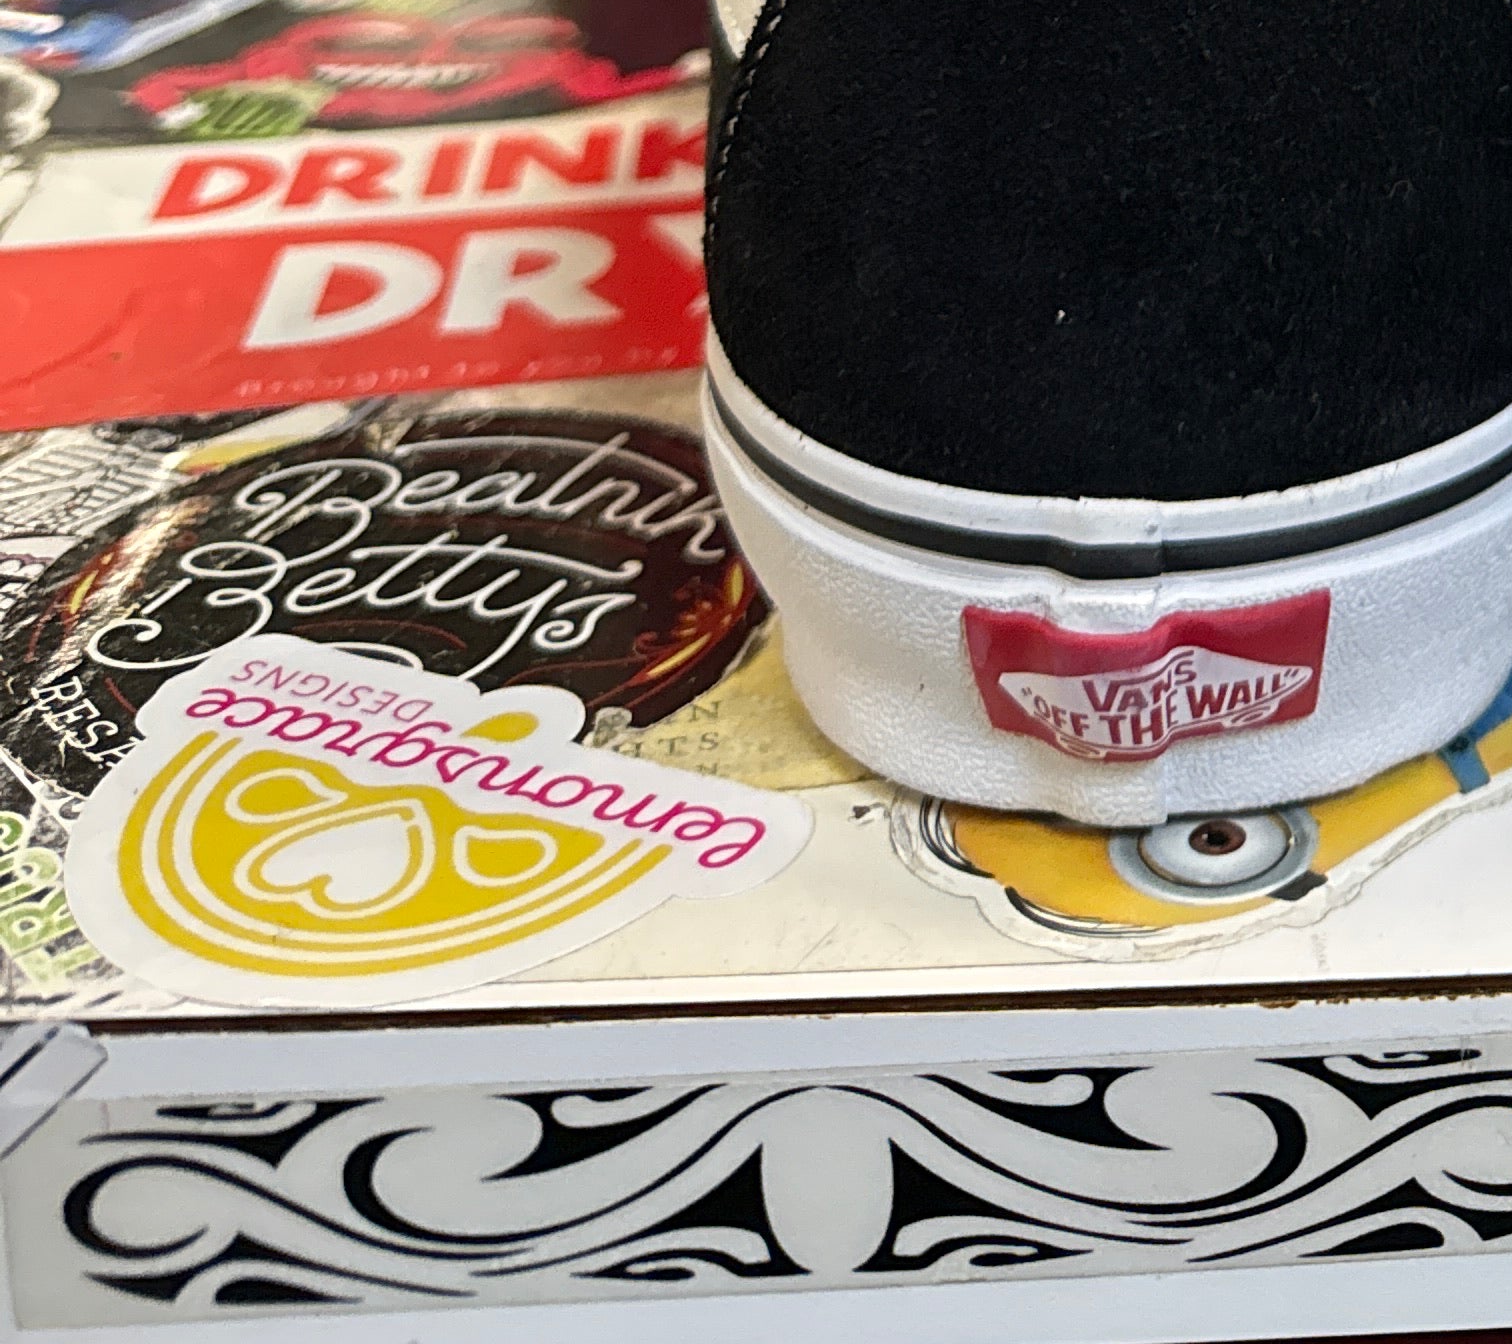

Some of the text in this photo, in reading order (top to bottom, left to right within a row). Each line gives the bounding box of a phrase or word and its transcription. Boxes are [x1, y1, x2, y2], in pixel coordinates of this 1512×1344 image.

[151, 121, 706, 223] DRINK
[235, 431, 725, 570] Beatnik
[231, 659, 433, 724] DESIGNS
[1081, 649, 1198, 713] VANS
[1099, 688, 1179, 746] THE
[186, 687, 767, 869] lemonsgrace
